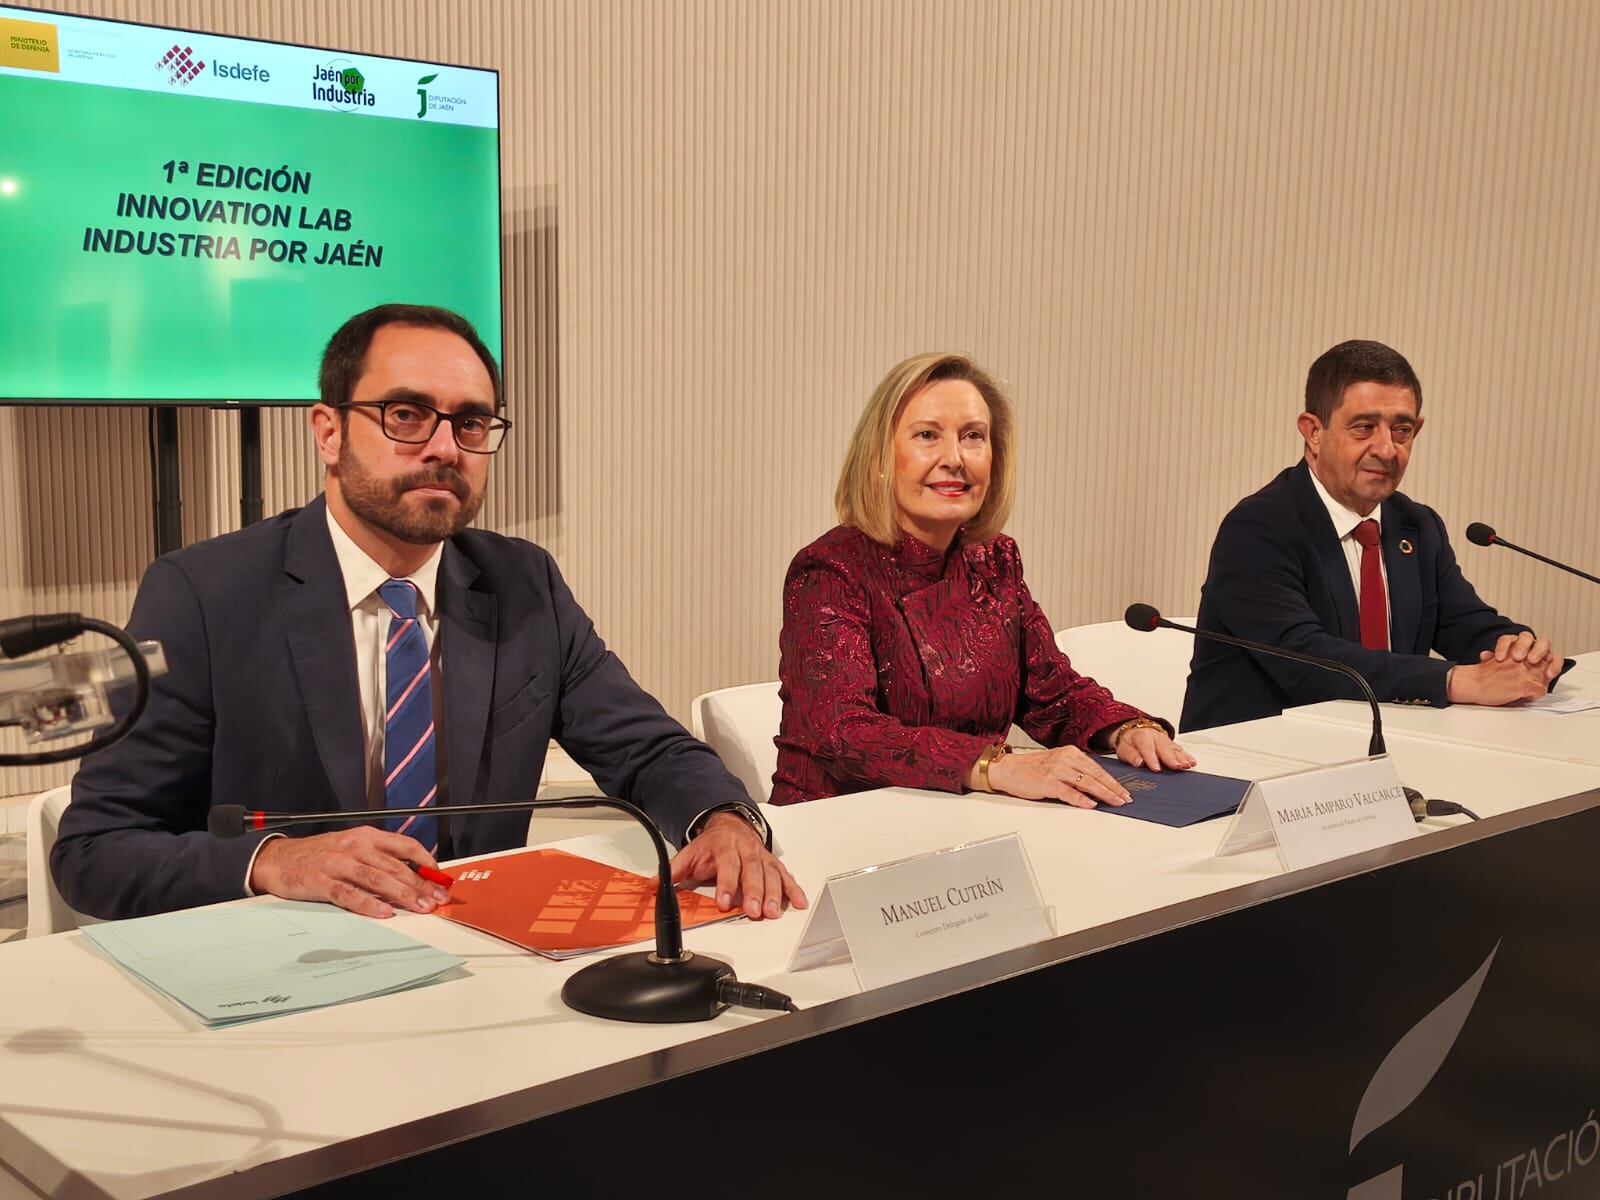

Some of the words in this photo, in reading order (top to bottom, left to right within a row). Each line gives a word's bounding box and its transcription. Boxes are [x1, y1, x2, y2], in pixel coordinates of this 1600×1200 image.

[10, 35, 47, 46] MINISTERIO
[11, 42, 20, 50] DE
[21, 43, 50, 53] DEFENSA
[213, 59, 270, 83] Isdefe
[313, 64, 343, 83] Jaén
[344, 73, 360, 87] por
[312, 82, 376, 107] Industria
[162, 160, 189, 183] 1ª
[196, 162, 312, 195] EDICIÓN
[116, 192, 292, 228] INNOVATION
[298, 207, 352, 232] LAB
[83, 227, 241, 260] INDUSTRIA
[249, 238, 308, 264] POR
[314, 240, 383, 268] JAÉN
[1314, 797, 1354, 817] AMPARO
[1353, 786, 1404, 807] VALCARCE
[880, 895, 946, 926] MANUEL
[946, 876, 1004, 907] CUTRÍN
[1428, 1109, 1600, 1200] UTACIÓ
